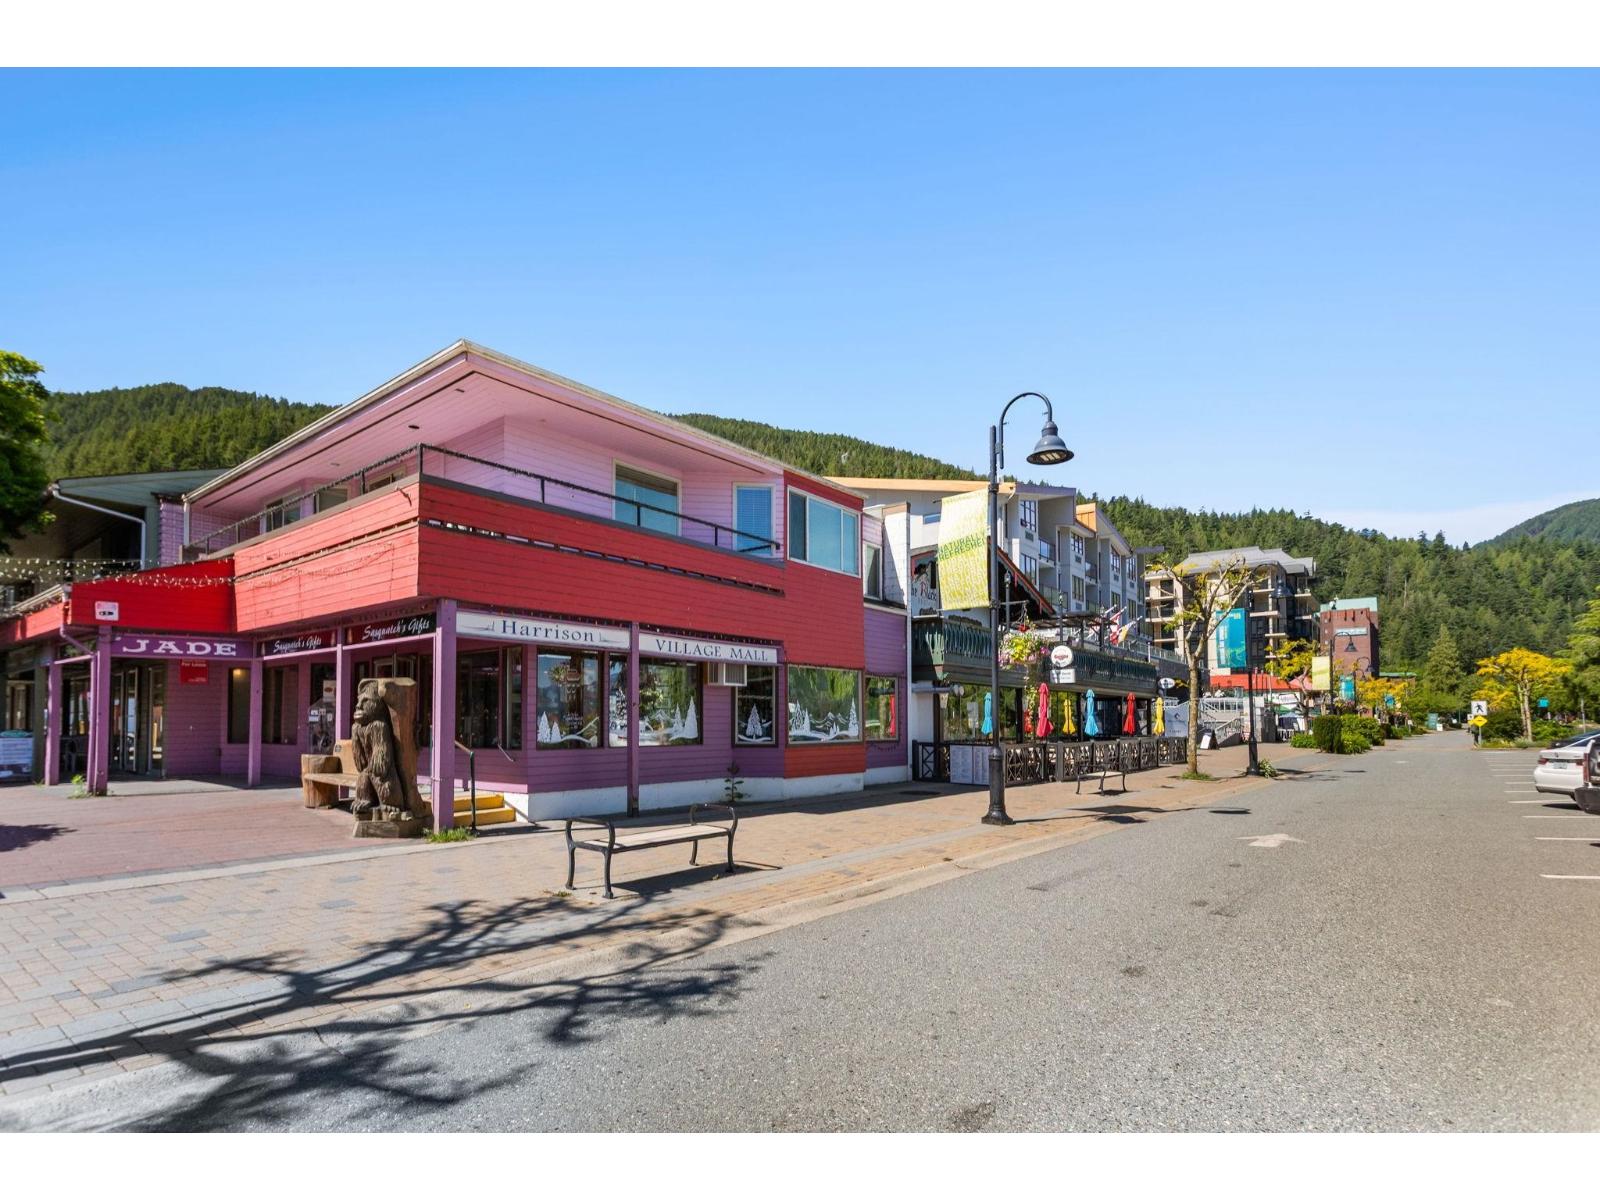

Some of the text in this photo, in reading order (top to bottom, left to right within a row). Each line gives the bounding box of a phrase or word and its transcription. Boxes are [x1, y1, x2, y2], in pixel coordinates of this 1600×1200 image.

[407, 617, 430, 635] Gifts
[502, 619, 594, 642] Harrison
[122, 639, 237, 656] JADE
[306, 634, 322, 649] Gifts
[655, 639, 768, 662] VILLAGE MALL
